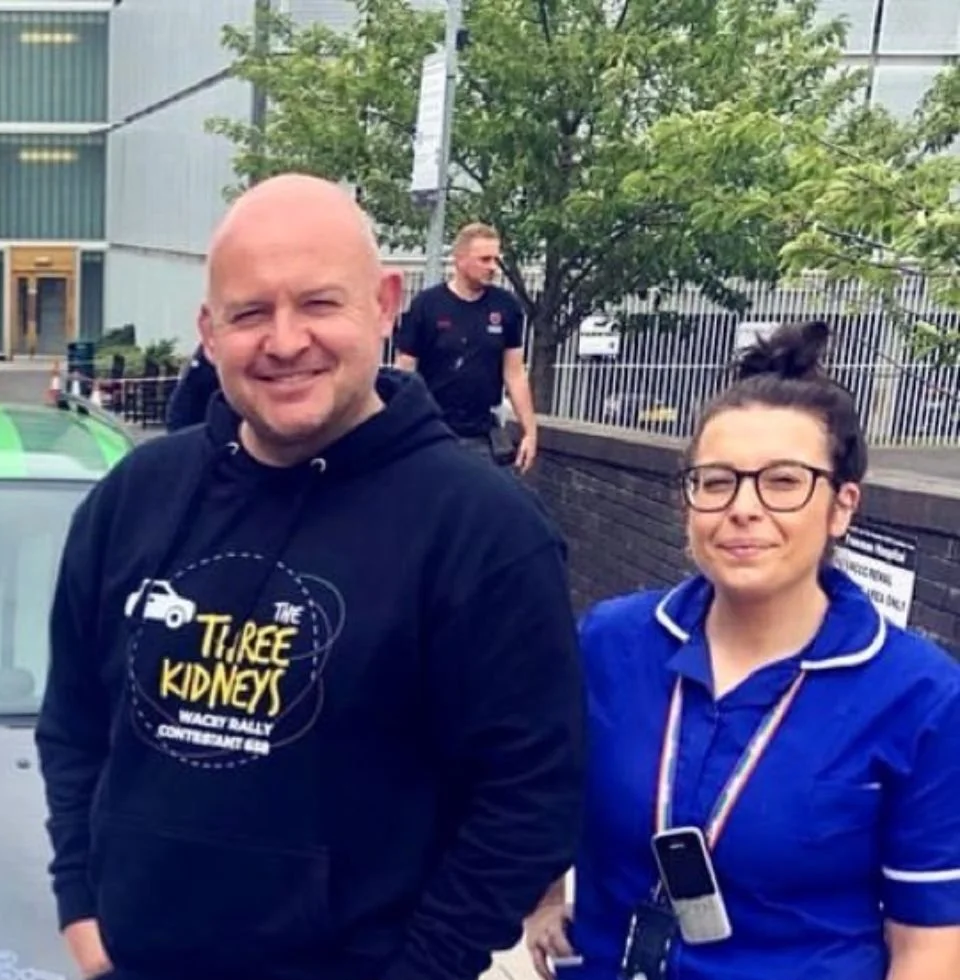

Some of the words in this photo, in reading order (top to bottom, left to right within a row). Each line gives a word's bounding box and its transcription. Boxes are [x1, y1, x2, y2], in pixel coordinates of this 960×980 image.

[273, 601, 304, 625] THE
[195, 612, 298, 668] THREE
[159, 657, 286, 718] KIDNEYS
[178, 708, 228, 729] WACKY
[227, 715, 275, 737] RALLY
[156, 724, 243, 751] CONTESTANT
